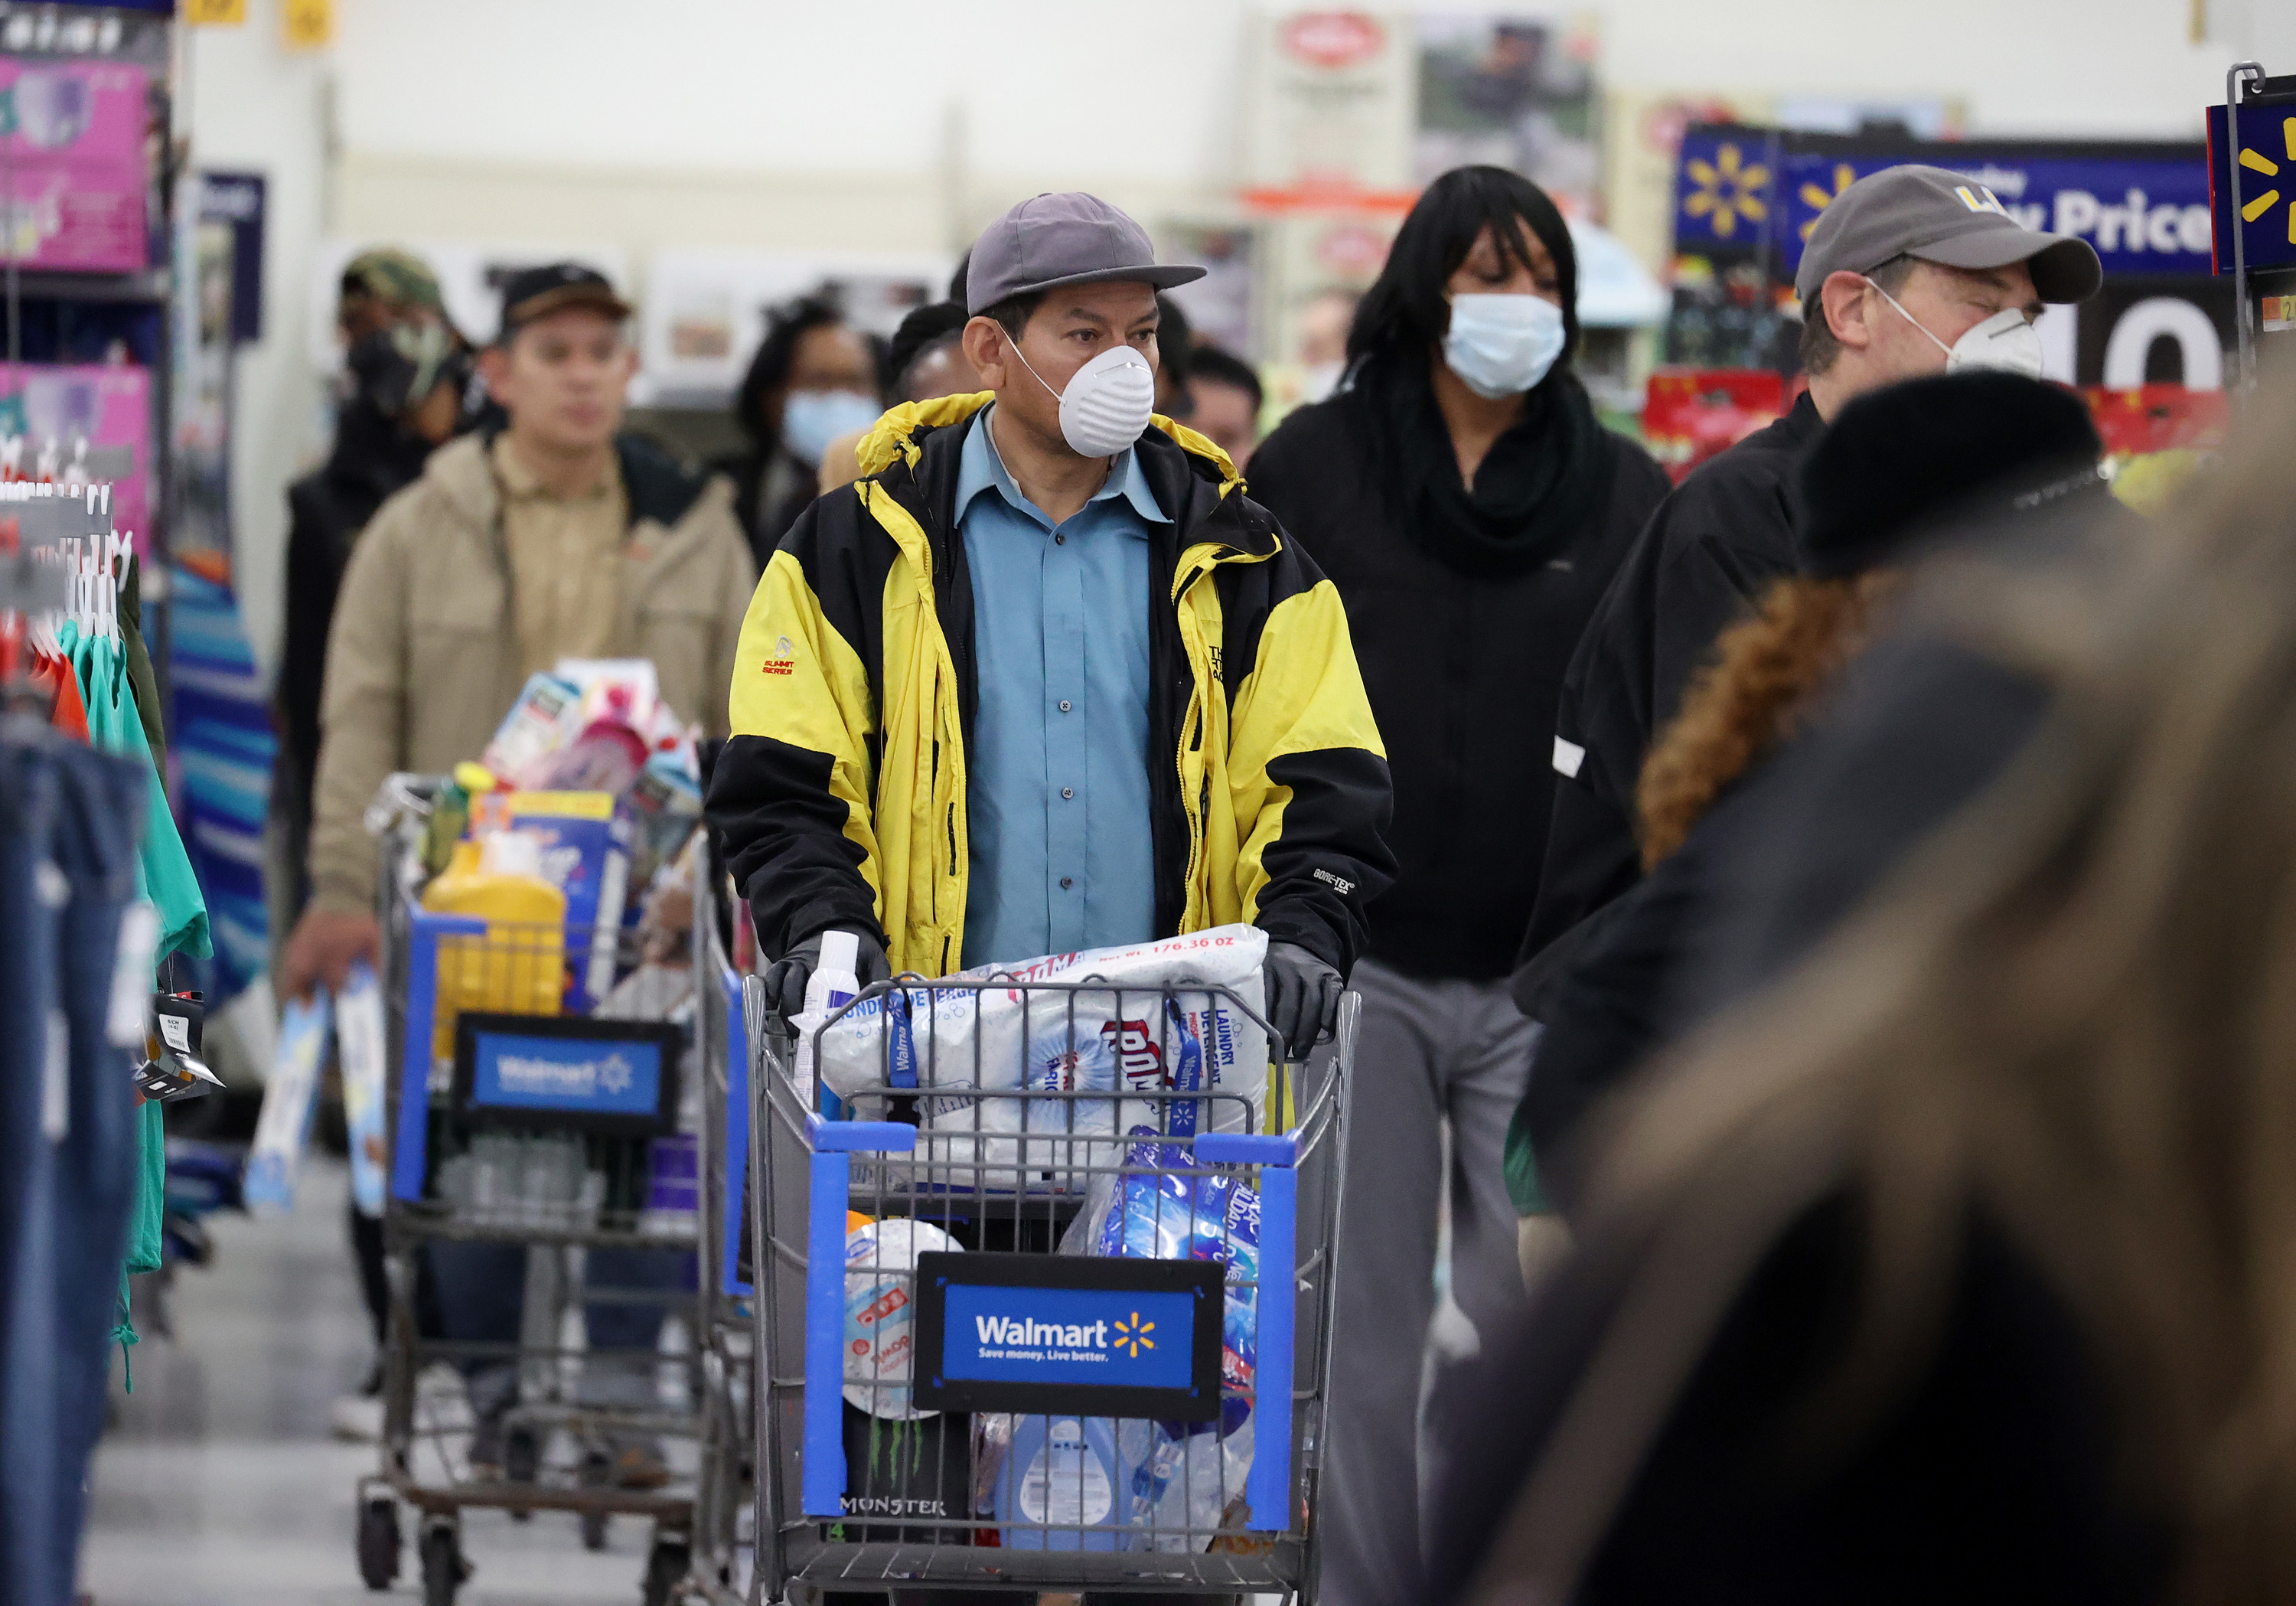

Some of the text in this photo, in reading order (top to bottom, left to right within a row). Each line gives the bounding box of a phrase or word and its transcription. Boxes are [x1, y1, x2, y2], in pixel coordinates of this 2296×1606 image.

[762, 667, 793, 675] SERIES
[1153, 938, 1210, 954] 176.36
[1216, 1009, 1234, 1066] LAUNDRY
[976, 1315, 1108, 1349] Walmart
[978, 1346, 1109, 1363] Save money. Live better.
[840, 1495, 947, 1517] MONSTER
